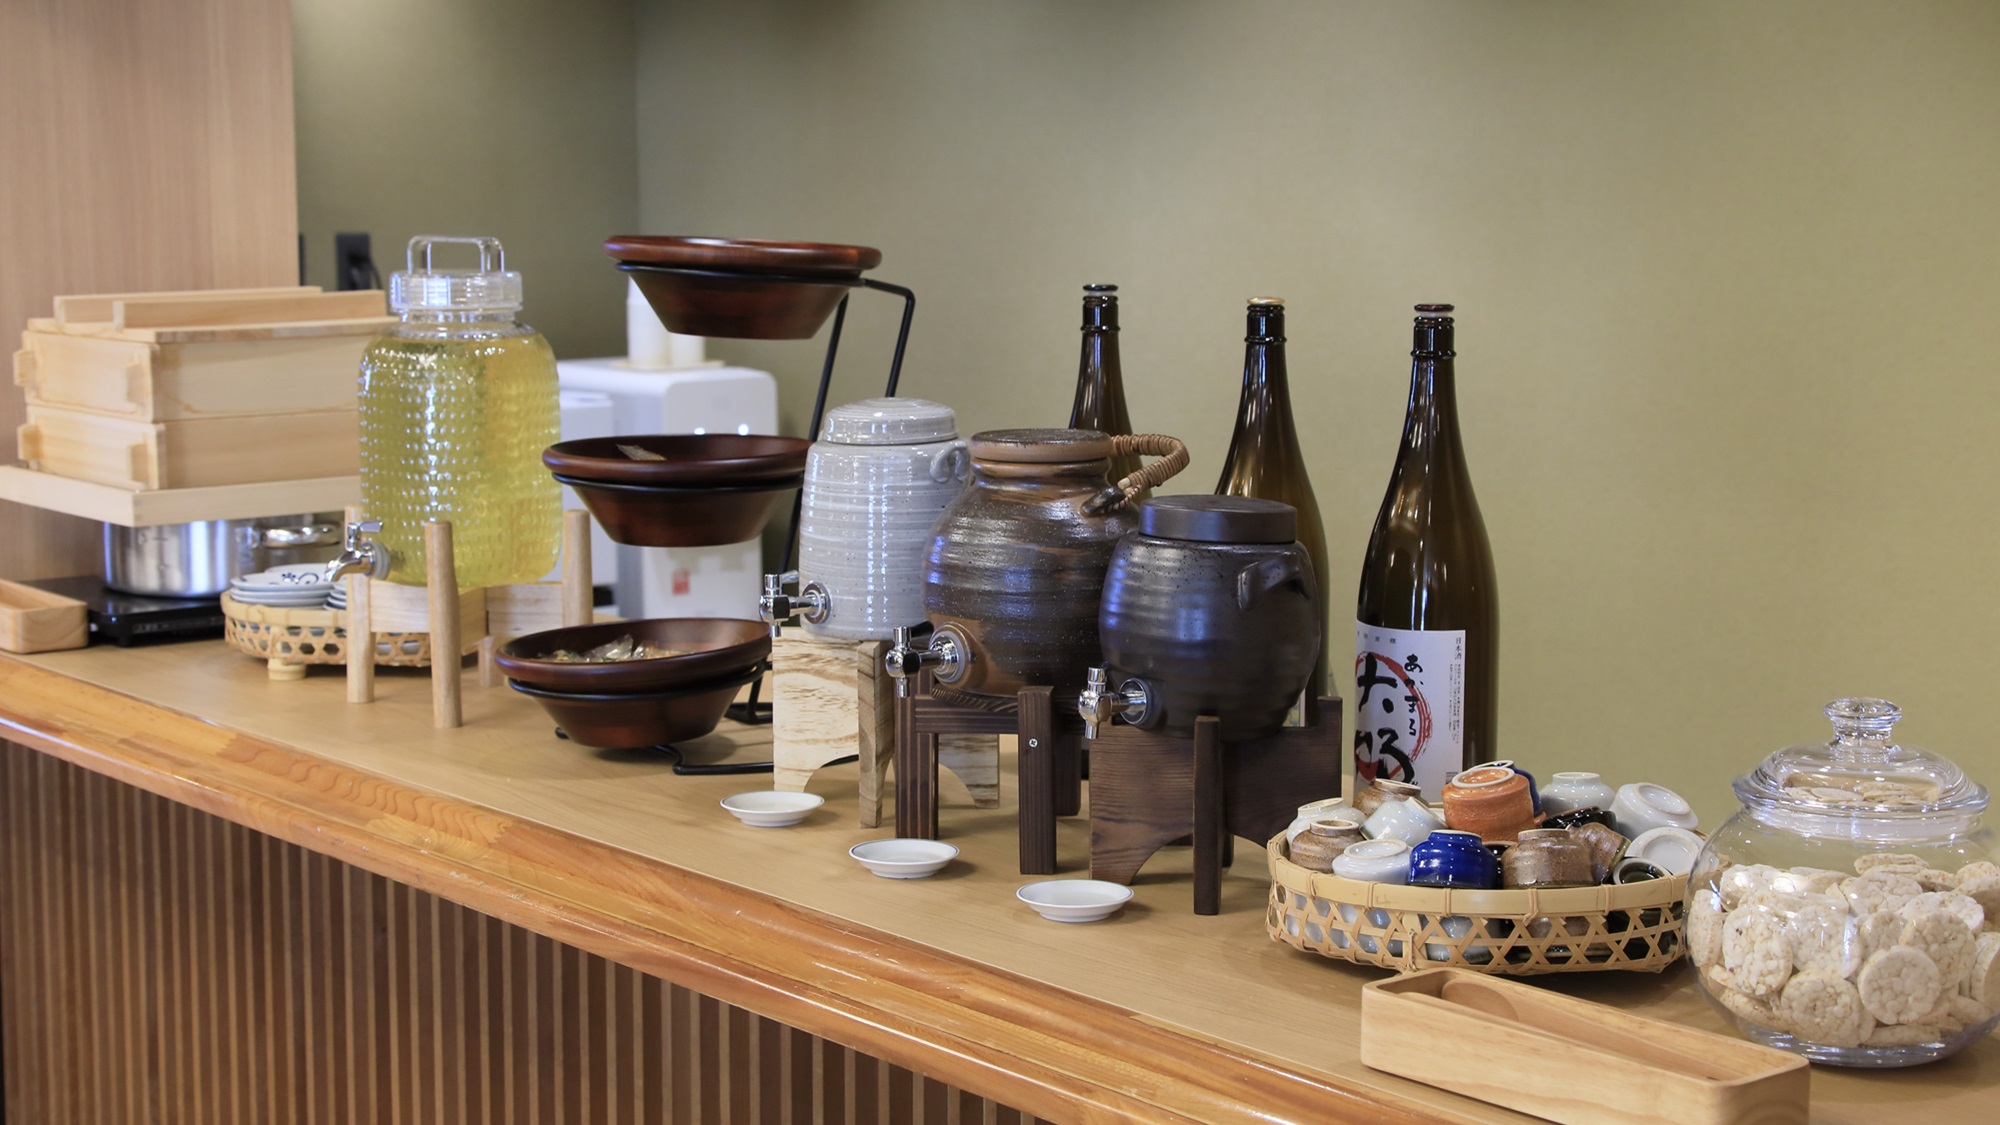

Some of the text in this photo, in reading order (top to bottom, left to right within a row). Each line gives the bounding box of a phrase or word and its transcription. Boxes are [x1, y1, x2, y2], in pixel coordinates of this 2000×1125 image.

[1454, 637, 1462, 660] 日本酒
[1404, 653, 1424, 736] あかまる
